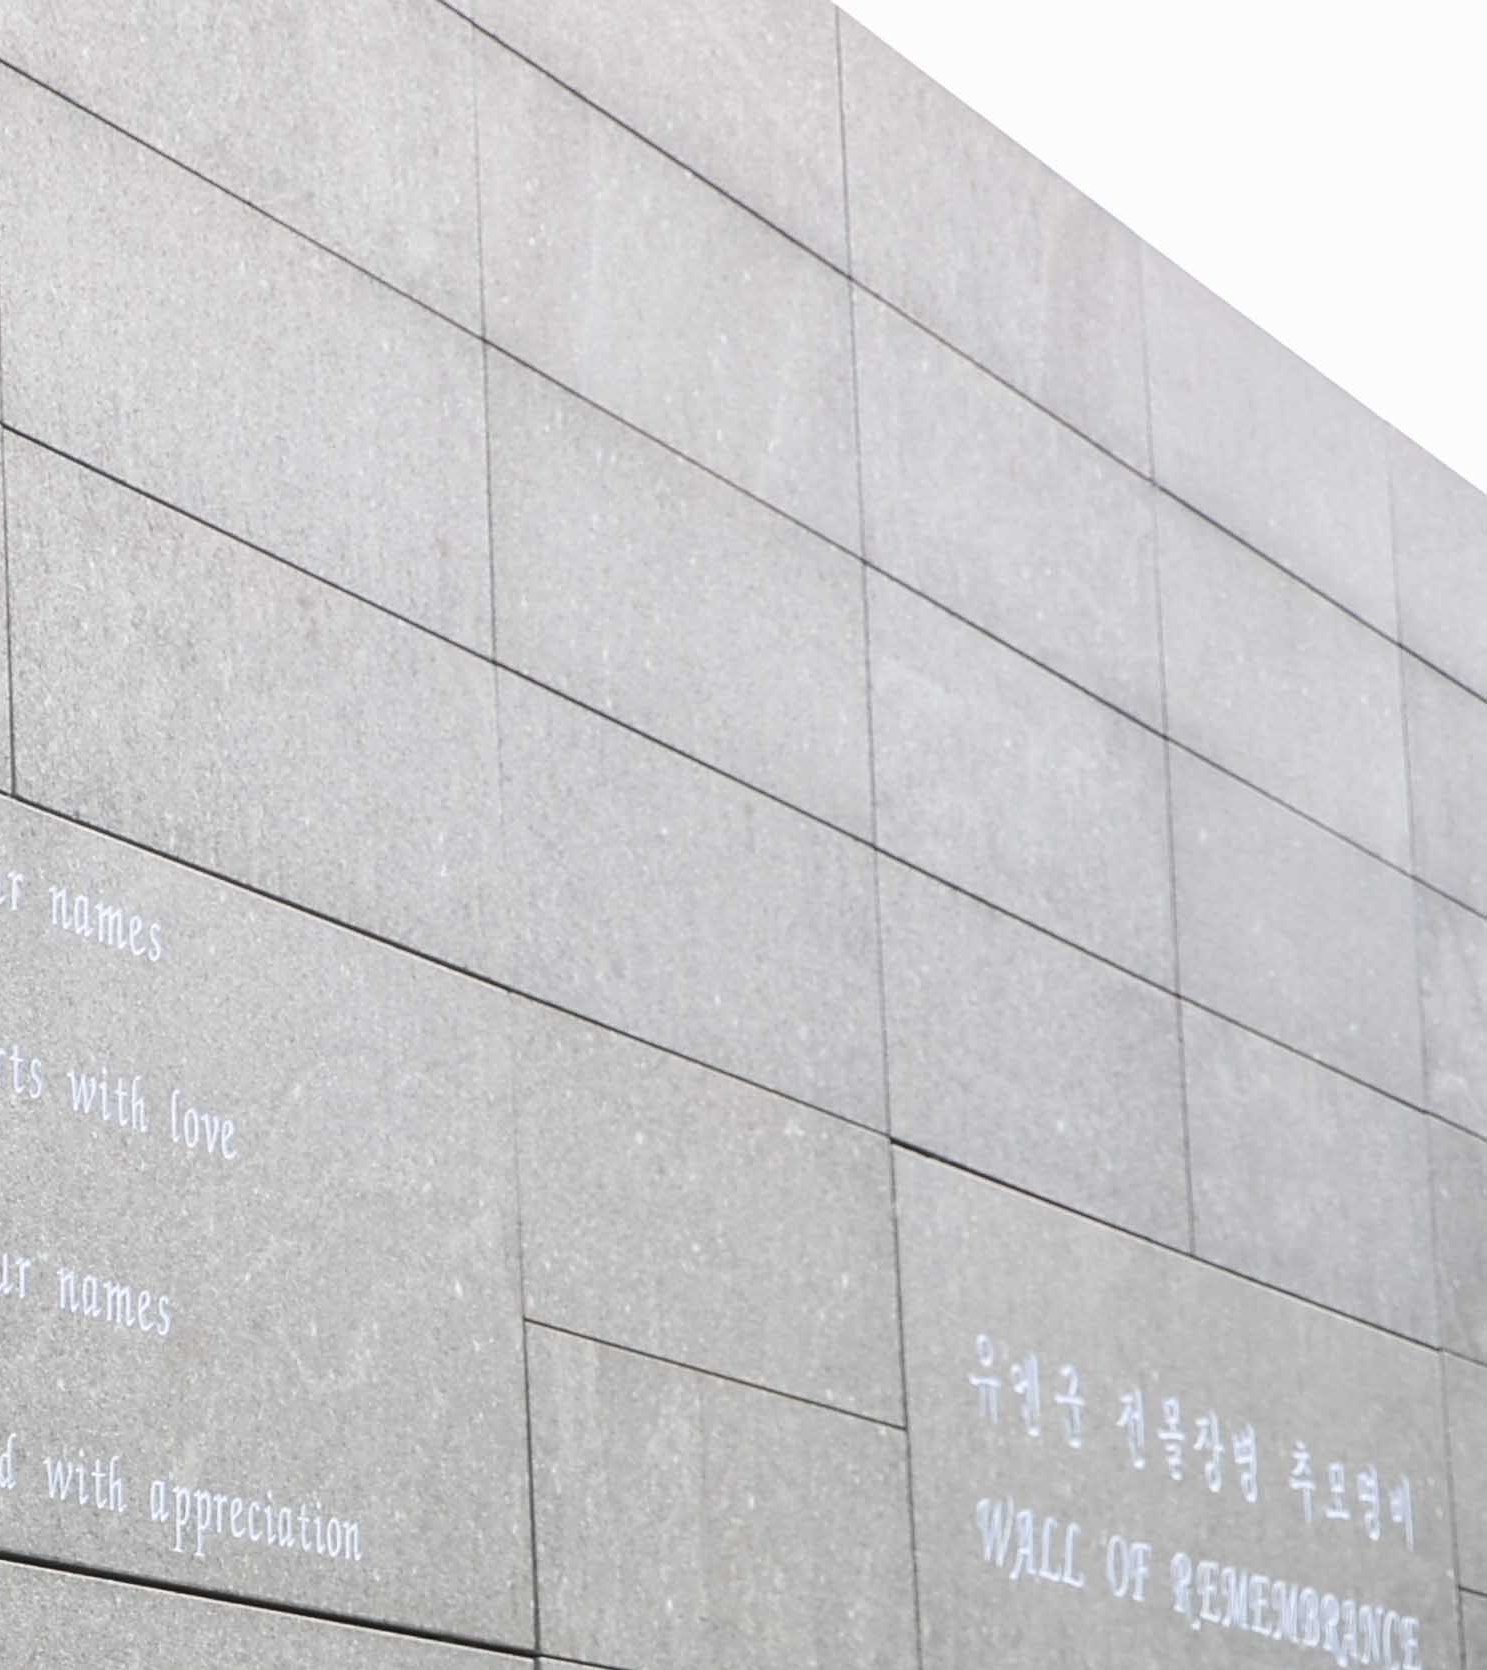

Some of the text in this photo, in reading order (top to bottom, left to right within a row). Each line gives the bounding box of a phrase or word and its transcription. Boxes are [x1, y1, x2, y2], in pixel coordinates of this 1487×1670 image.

[49, 880, 163, 962] names
[67, 1064, 149, 1134] with
[170, 1088, 239, 1161] love
[57, 1260, 173, 1336] names
[44, 1447, 127, 1514] with
[149, 1473, 363, 1563] appreciation
[976, 1496, 1085, 1590] WALL
[1106, 1534, 1153, 1602] OF
